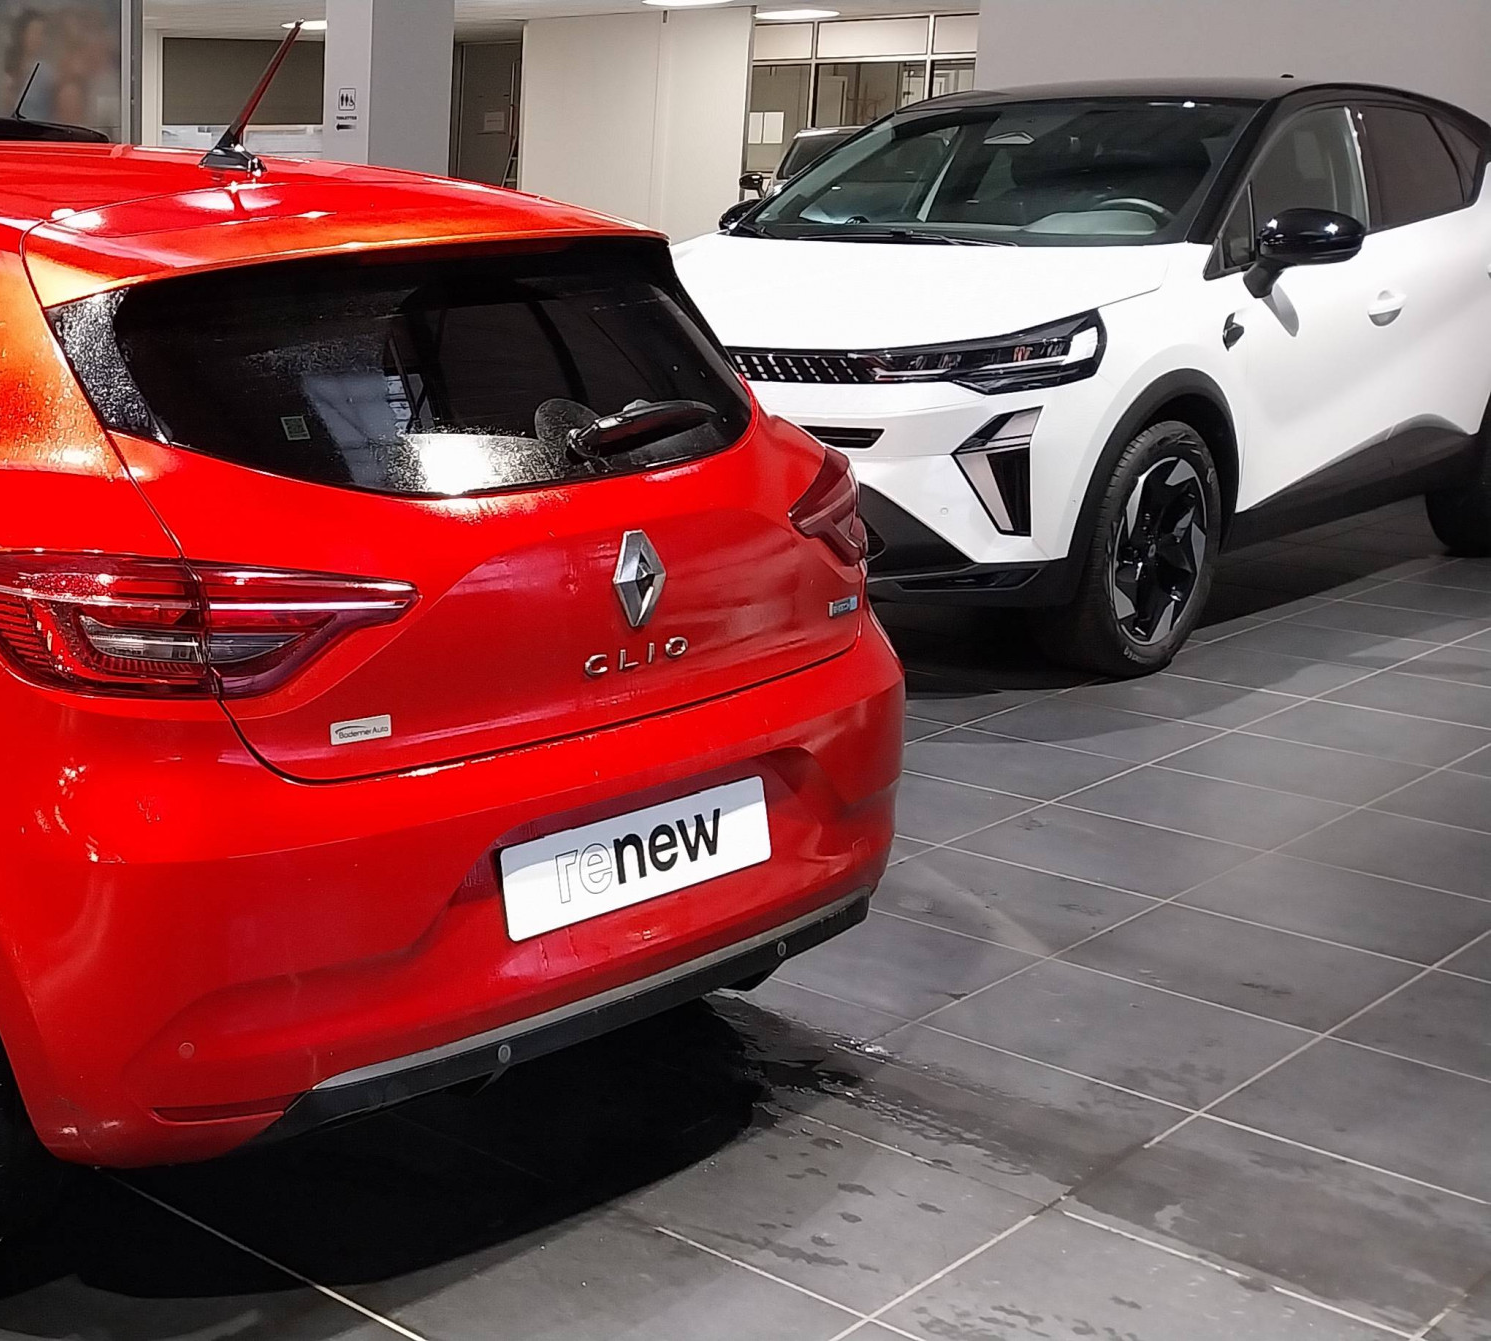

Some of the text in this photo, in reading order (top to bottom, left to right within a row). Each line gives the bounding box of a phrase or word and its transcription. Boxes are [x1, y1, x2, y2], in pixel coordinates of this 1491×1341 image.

[585, 636, 688, 676] CLIO
[372, 726, 389, 734] Auto
[555, 808, 721, 903] renew
